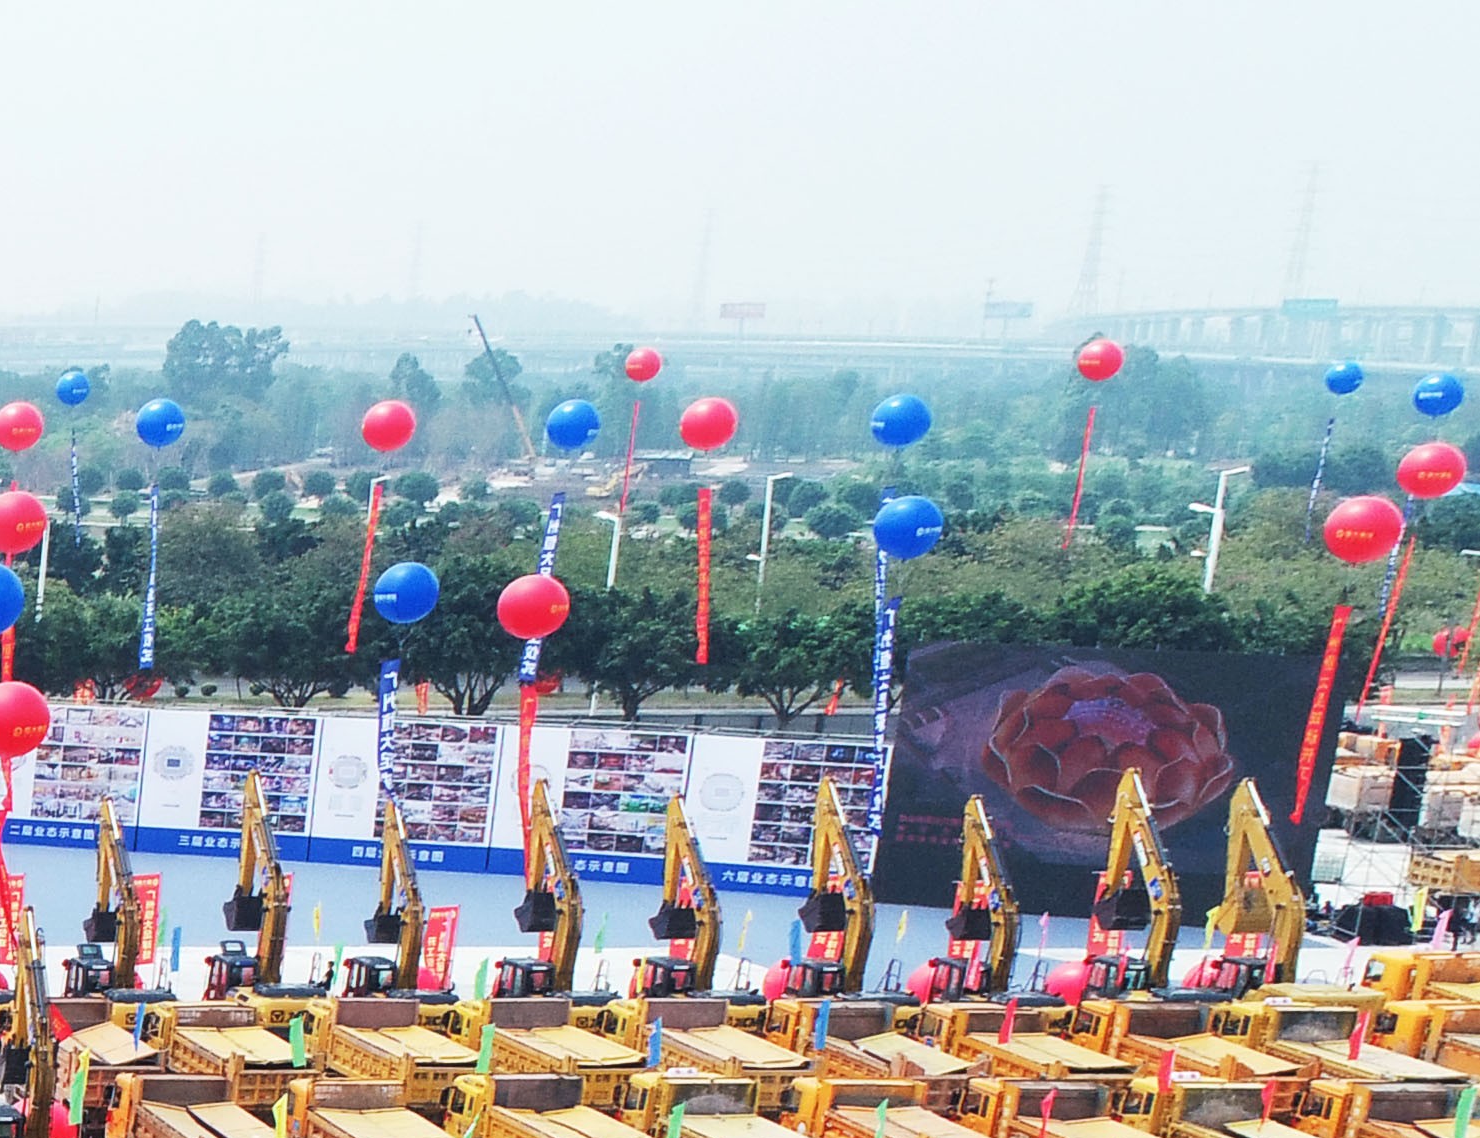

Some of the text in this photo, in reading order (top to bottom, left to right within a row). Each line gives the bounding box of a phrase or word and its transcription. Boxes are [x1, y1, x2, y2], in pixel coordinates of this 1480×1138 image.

[9, 825, 95, 840] 二层业态示意图
[352, 846, 444, 862] 四层示意图
